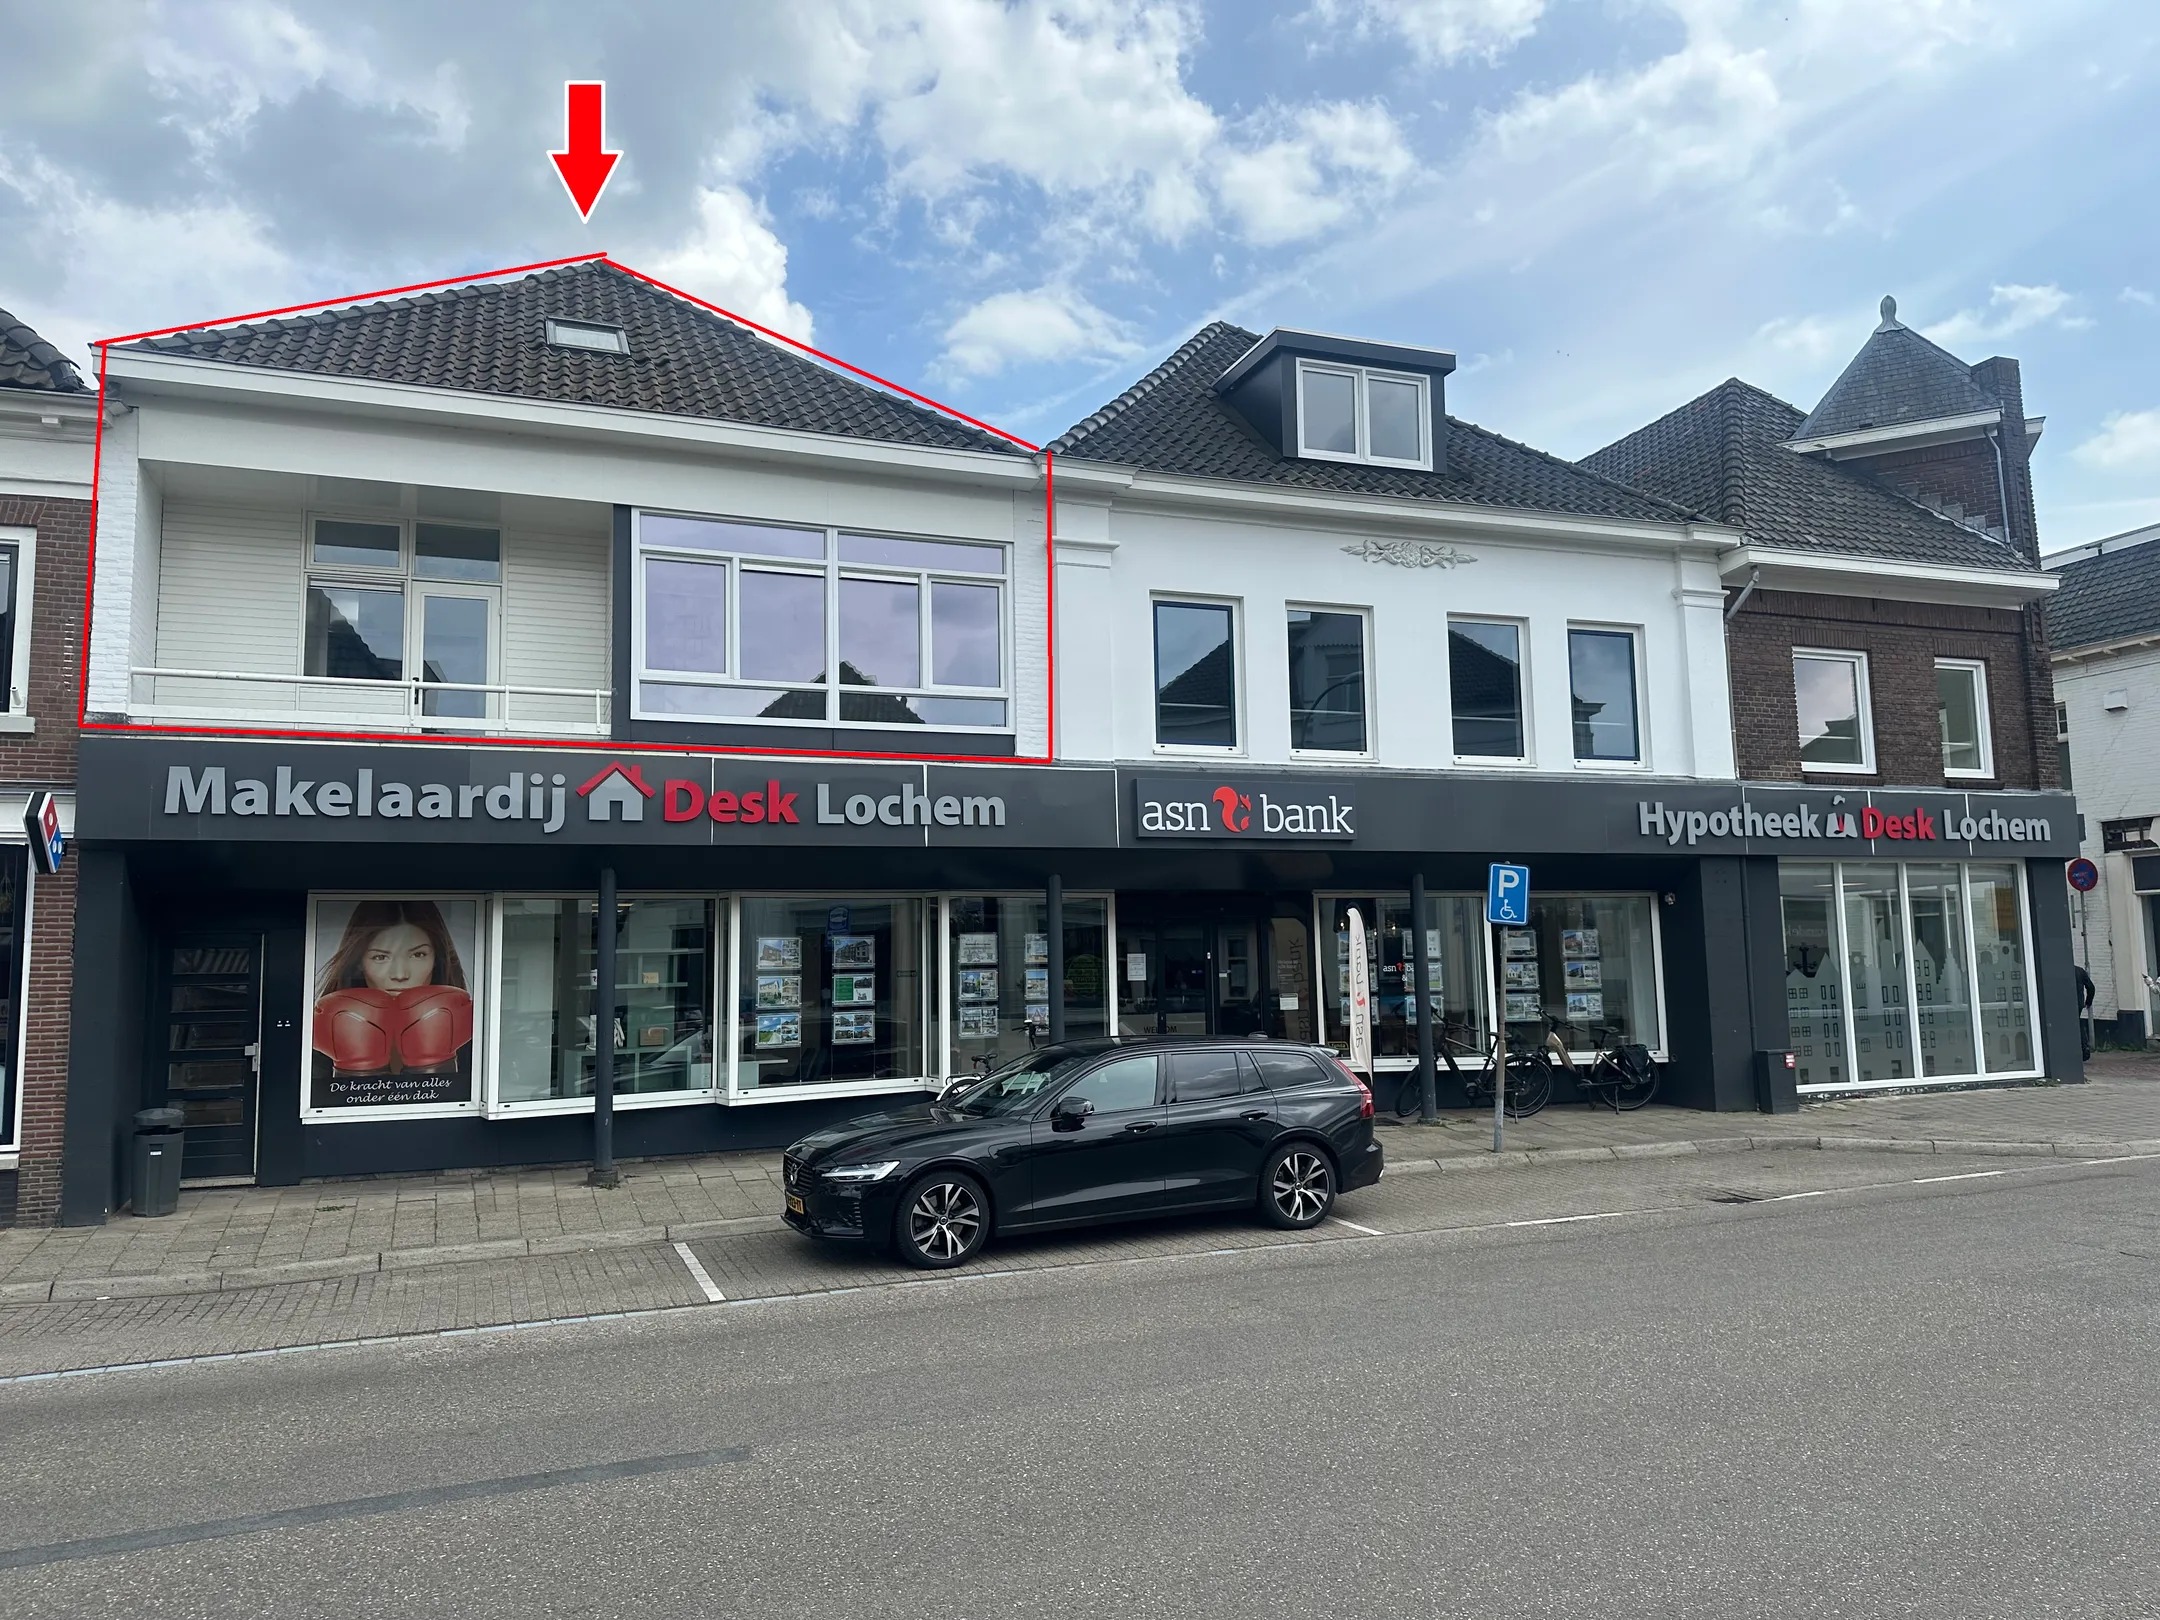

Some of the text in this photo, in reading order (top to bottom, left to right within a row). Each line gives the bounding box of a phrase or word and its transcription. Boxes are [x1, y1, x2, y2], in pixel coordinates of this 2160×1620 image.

[163, 765, 1006, 834] Makelaardij Desk Lochem
[1141, 793, 1354, 834] asn bank
[1638, 801, 2052, 846] Hypotheek Desk Lochem
[1498, 869, 1520, 898] P
[330, 1077, 452, 1093] De kracht van alles
[346, 1089, 440, 1104] onder één dak
